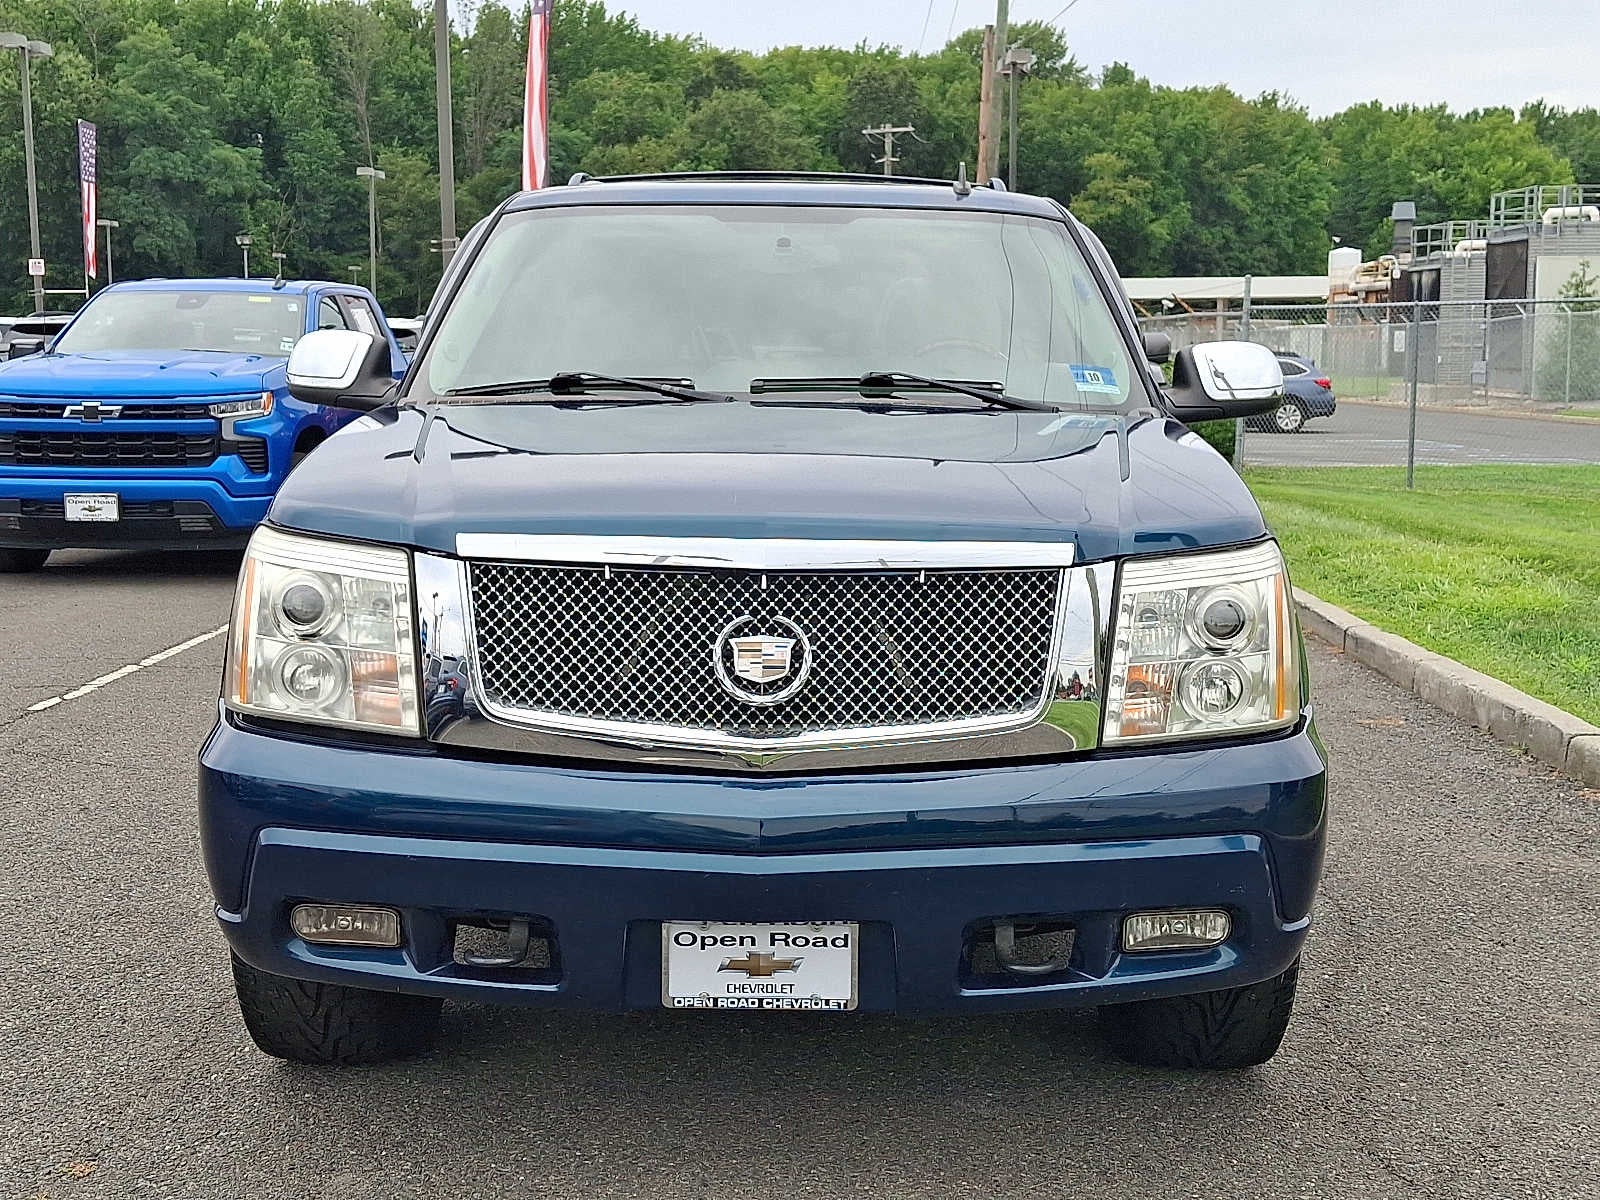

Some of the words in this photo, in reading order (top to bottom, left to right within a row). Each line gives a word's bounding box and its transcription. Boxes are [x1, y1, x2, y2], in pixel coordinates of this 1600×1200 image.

[1087, 372, 1101, 382] 10
[673, 931, 756, 950] Open
[769, 932, 849, 948] Road
[726, 983, 796, 994] CHEVROLET
[674, 997, 714, 1007] OPEN
[717, 997, 759, 1008] ROAD
[762, 998, 847, 1009] CHEVROLET
